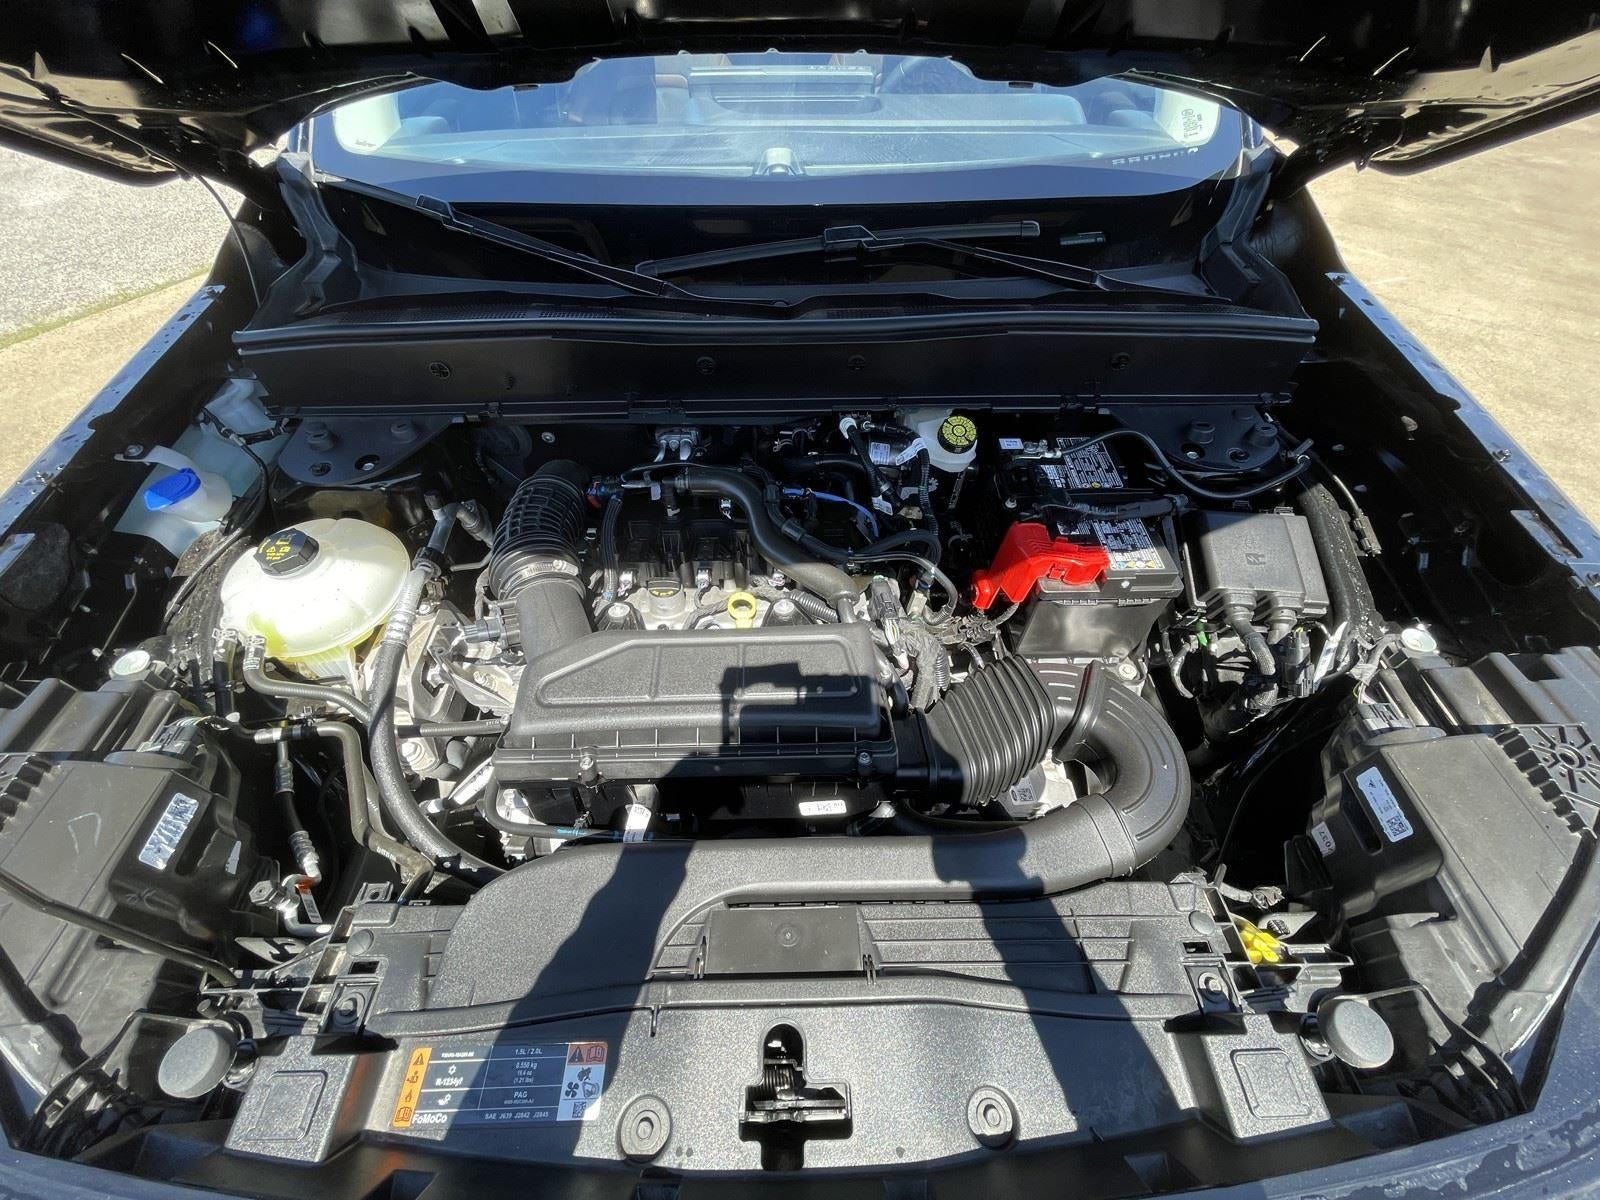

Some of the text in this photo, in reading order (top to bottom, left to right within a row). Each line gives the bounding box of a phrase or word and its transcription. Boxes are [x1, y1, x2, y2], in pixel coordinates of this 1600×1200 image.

[435, 1077, 464, 1087] R-1234yf
[513, 1091, 528, 1099] PAG
[411, 1112, 448, 1124] FoMoCo
